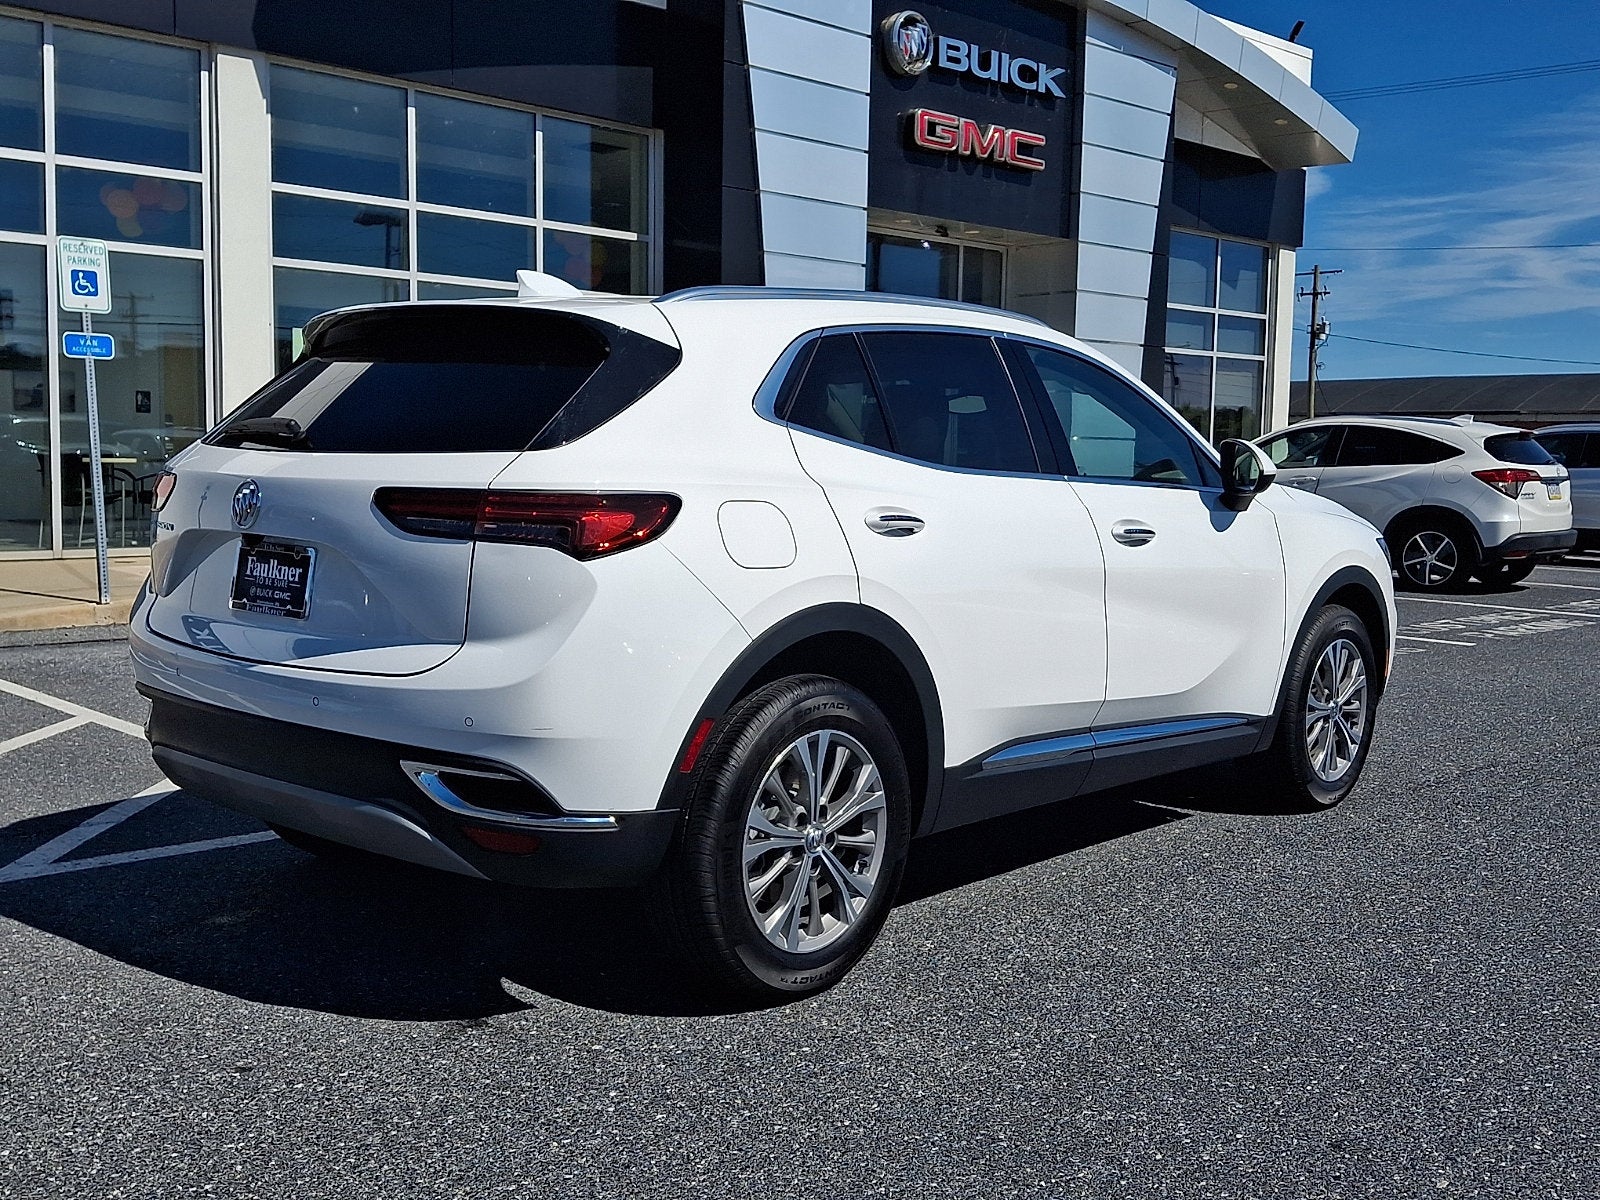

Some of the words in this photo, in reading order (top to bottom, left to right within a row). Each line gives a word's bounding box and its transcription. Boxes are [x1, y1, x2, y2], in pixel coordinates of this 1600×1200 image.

[938, 35, 1067, 99] BUICK
[914, 108, 1046, 171] GMC
[62, 243, 104, 256] RESERVED
[67, 255, 101, 267] PARKING
[79, 338, 98, 347] VAN
[246, 556, 303, 582] Faulkner
[274, 579, 289, 588] SURE
[256, 588, 273, 598] BUICK
[273, 591, 292, 600] GMC
